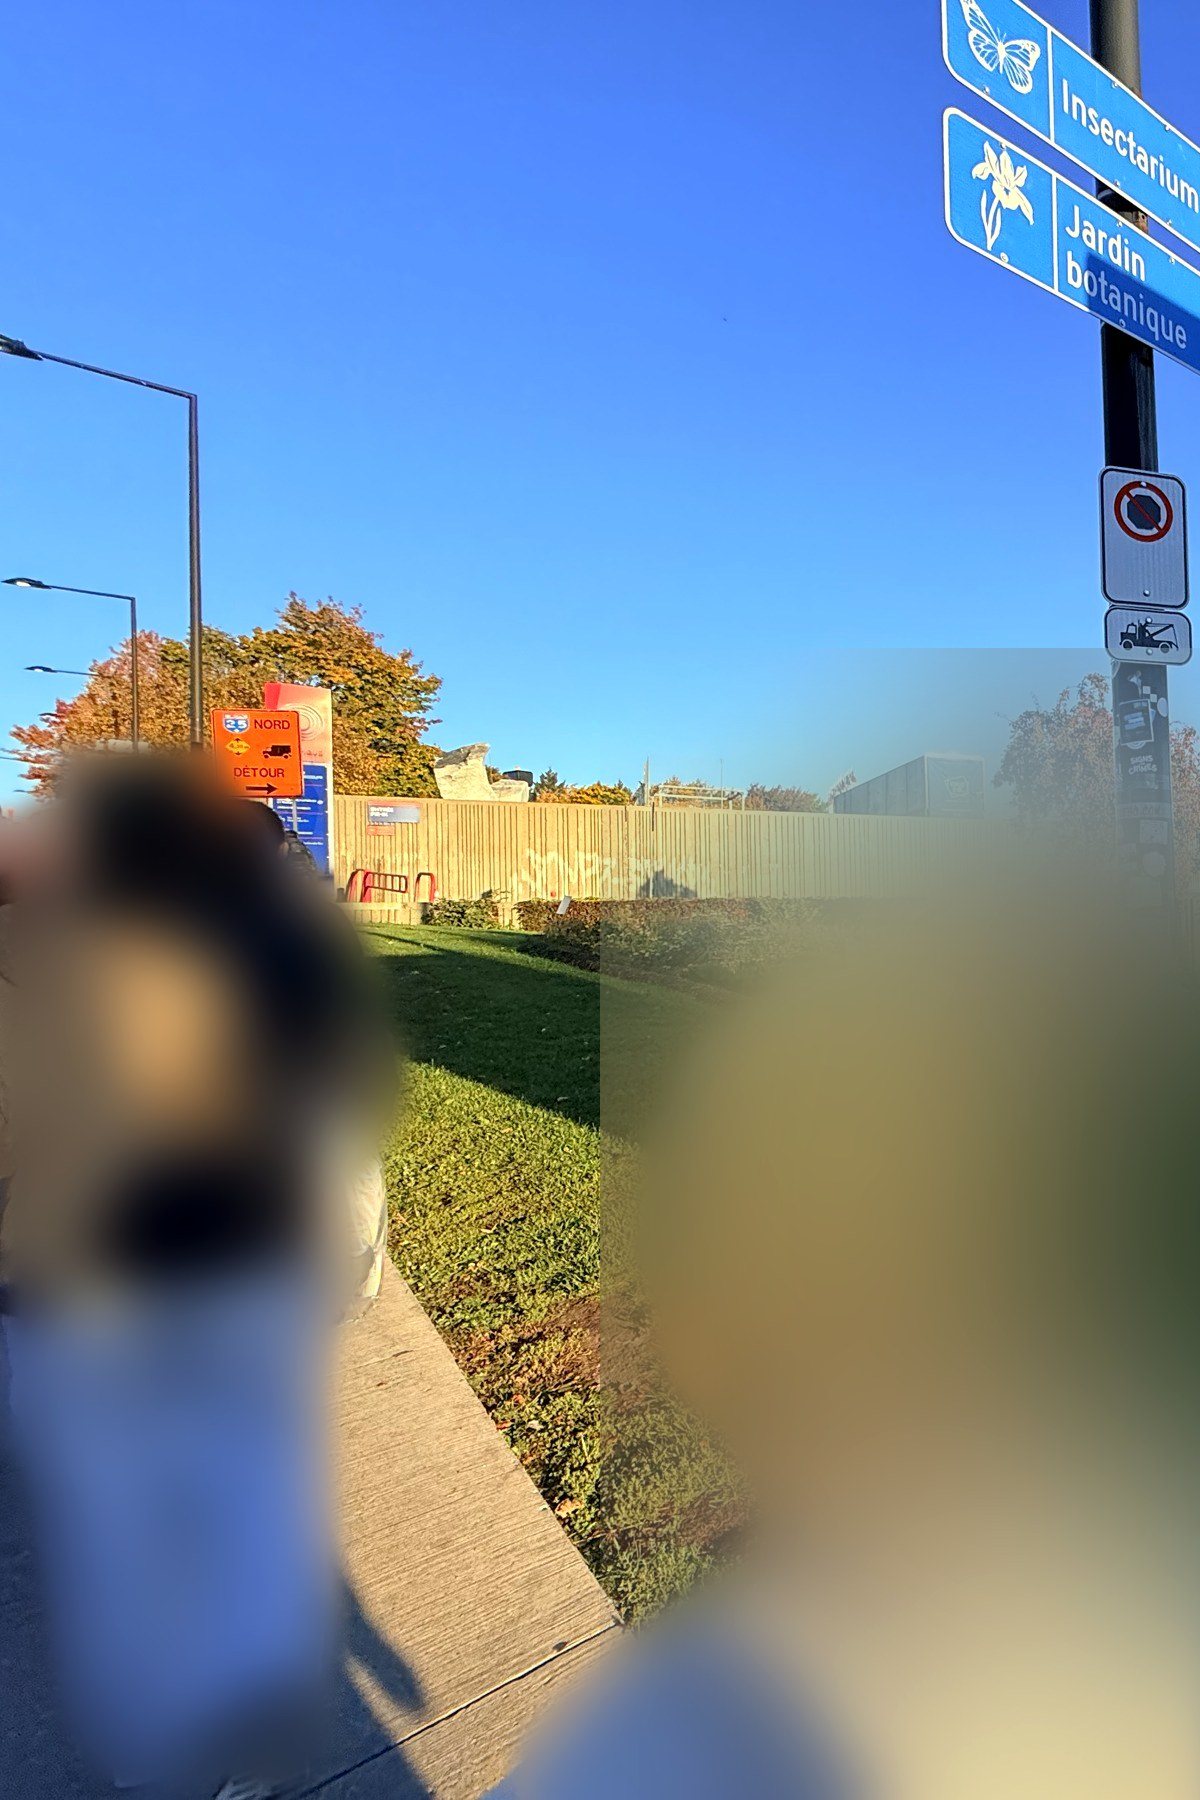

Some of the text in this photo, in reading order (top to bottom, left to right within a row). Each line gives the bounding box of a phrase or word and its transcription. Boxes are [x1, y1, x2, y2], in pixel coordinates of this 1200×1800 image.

[1062, 78, 1200, 214] Insectarium
[1065, 205, 1146, 282] Jardin
[1066, 250, 1188, 350] botanique
[254, 719, 291, 730] NORD
[233, 765, 285, 778] DÉTOUR
